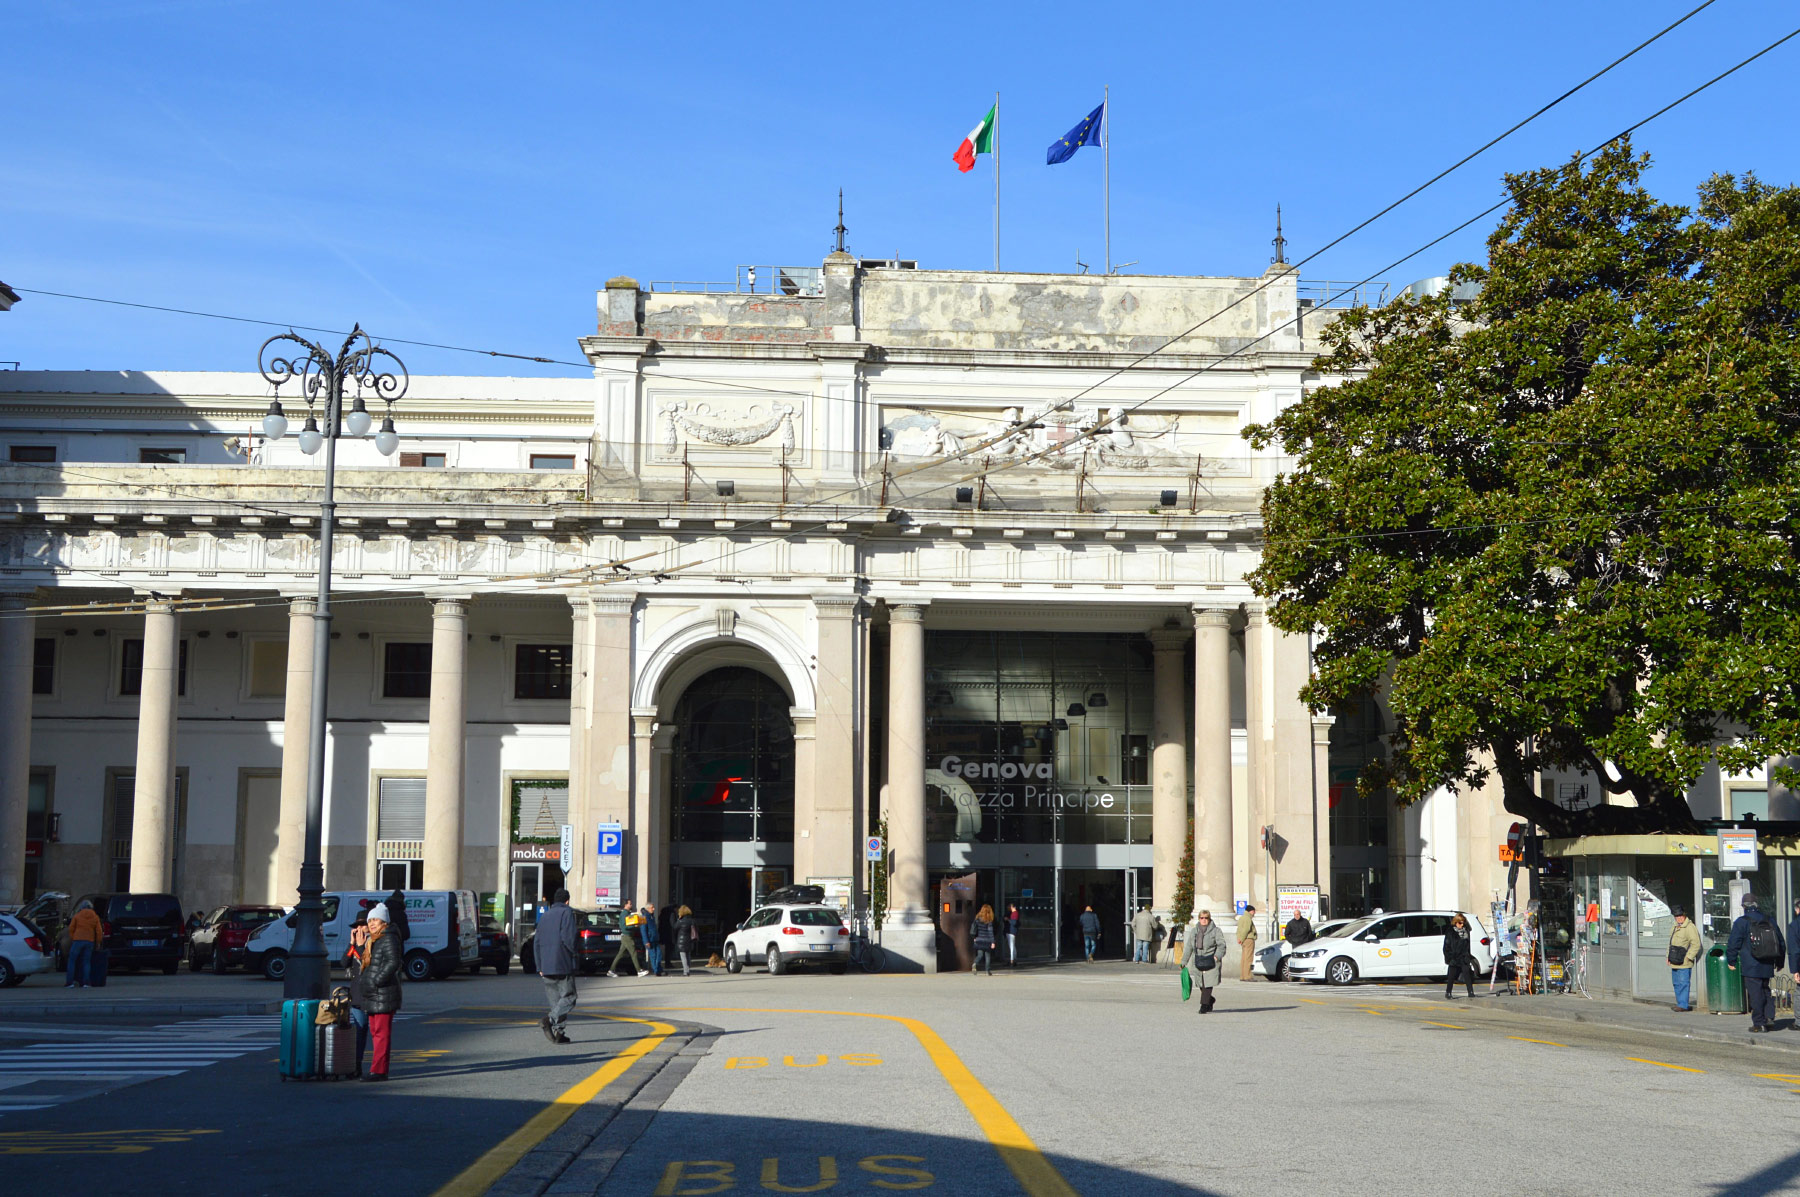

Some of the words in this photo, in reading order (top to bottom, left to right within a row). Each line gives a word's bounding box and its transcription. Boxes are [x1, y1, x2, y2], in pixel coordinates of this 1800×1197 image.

[940, 755, 1053, 779] Genova
[939, 785, 1014, 808] Piazza
[1025, 785, 1114, 813] Principe
[602, 833, 617, 853] P
[724, 1053, 884, 1069] BUS
[653, 1154, 936, 1196] BUS
